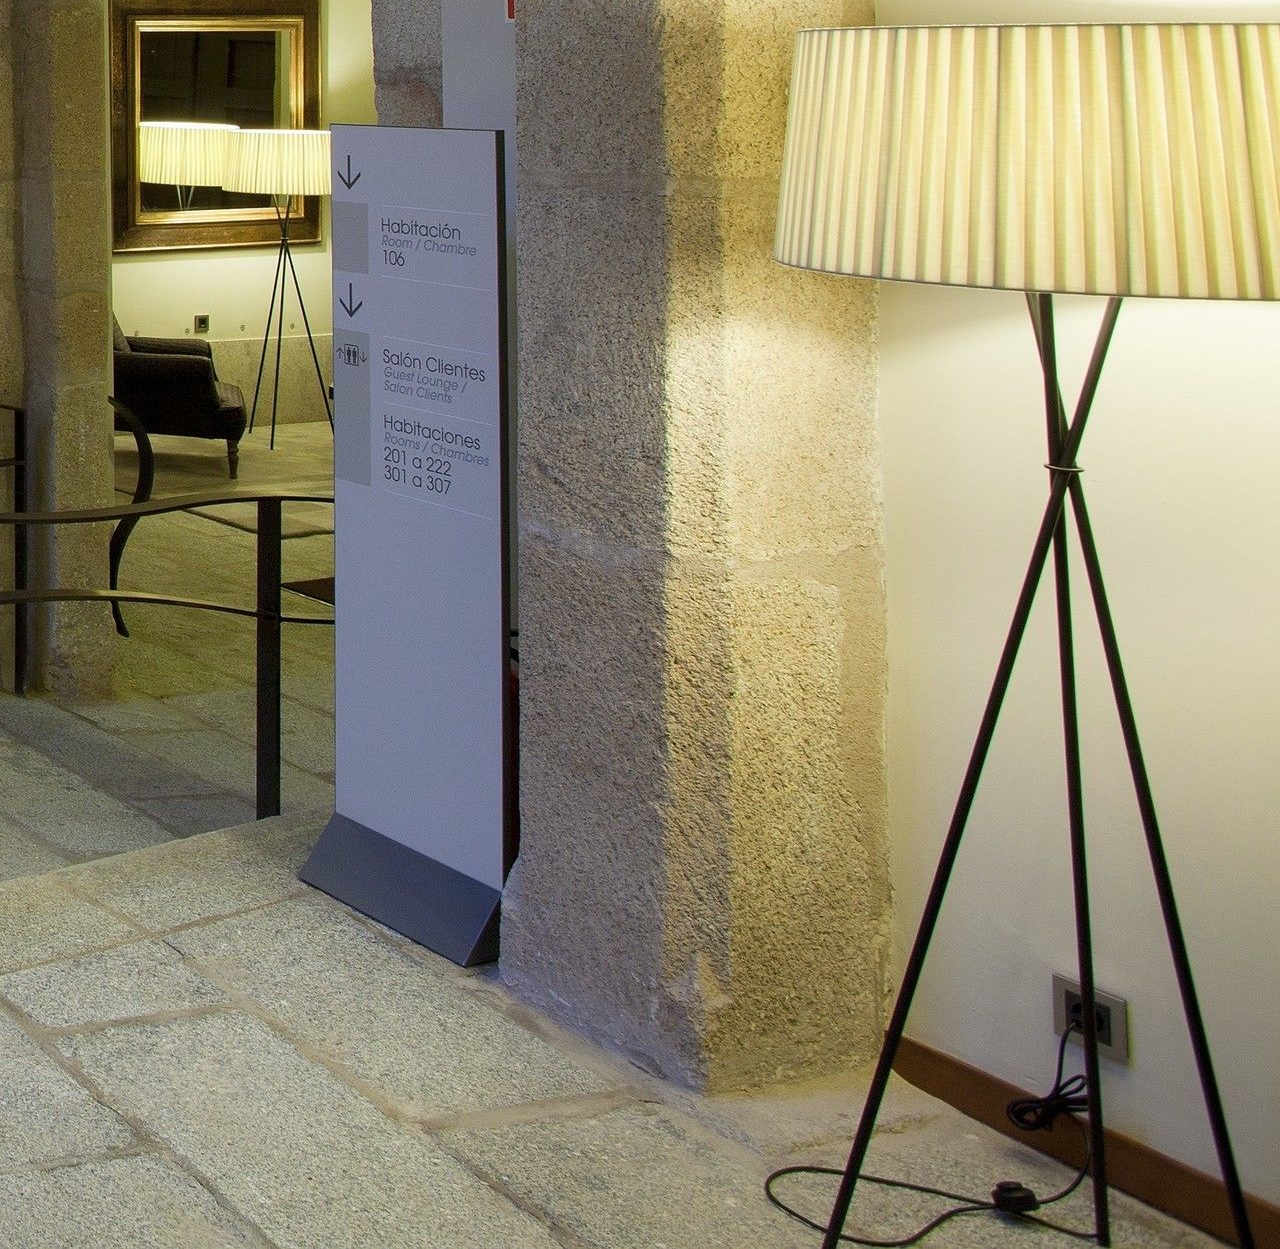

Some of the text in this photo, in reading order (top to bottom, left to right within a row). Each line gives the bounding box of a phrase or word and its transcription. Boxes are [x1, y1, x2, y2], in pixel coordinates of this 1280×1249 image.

[381, 218, 460, 240] Habitación
[382, 235, 413, 249] Room
[424, 239, 477, 256] Chambre
[383, 250, 405, 266] 106
[383, 349, 486, 382] Salón Clientes
[384, 366, 414, 382] Guest
[417, 373, 458, 391] Lounge
[384, 380, 453, 404] Salon Clients
[384, 414, 480, 450] Habitaciones
[384, 432, 421, 450] Rooms
[431, 443, 490, 467] Chambres
[384, 447, 452, 477] 201 a 222
[384, 465, 451, 494] 301 a 307
